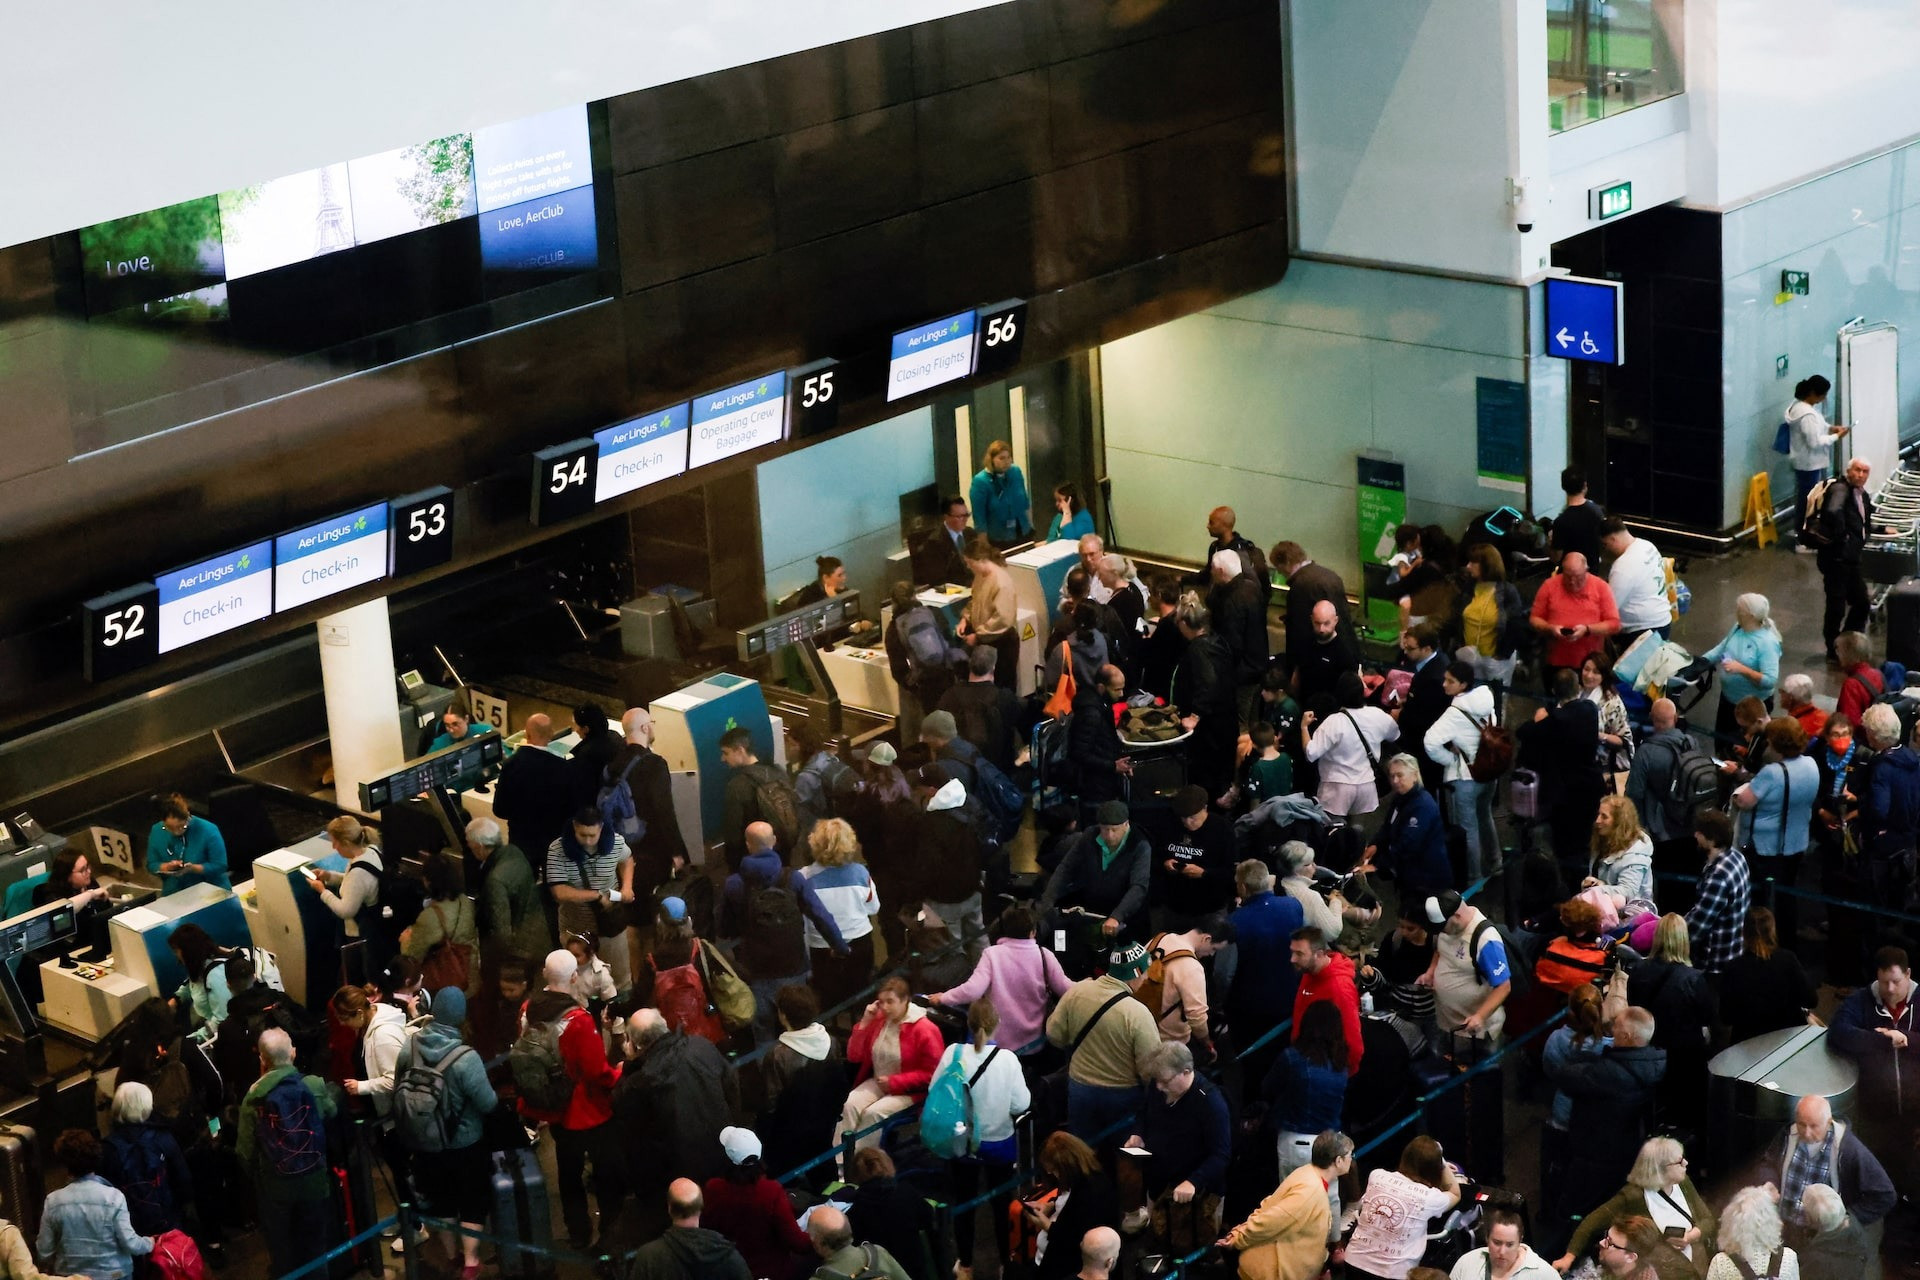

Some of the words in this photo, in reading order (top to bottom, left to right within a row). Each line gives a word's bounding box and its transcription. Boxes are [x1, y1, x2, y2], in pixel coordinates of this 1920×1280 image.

[546, 150, 566, 161] every
[518, 171, 534, 182] take
[535, 166, 552, 177] with
[486, 192, 512, 204] money
[523, 182, 546, 194] future
[498, 217, 524, 232] Love,
[526, 204, 564, 224] AerClub
[907, 335, 922, 348] Aer
[922, 327, 948, 345] Lingus
[985, 314, 1017, 348] 56
[896, 362, 931, 384] Closing
[932, 350, 965, 371] Flights
[710, 397, 726, 411] Aer
[726, 389, 754, 409] Lingus
[802, 371, 834, 408] 55
[612, 431, 631, 445] Aer
[631, 420, 658, 440] Lingus
[700, 416, 749, 441] Operating
[751, 406, 775, 425] Crew
[716, 428, 758, 451] Baggage
[549, 456, 588, 494] 54
[613, 451, 663, 479] Check-in
[298, 533, 317, 550] Aer
[317, 523, 351, 545] Lingus
[407, 503, 446, 543] 53
[178, 575, 198, 591] Aer
[199, 563, 234, 585] Lingus
[302, 555, 359, 585] Check-in
[183, 595, 243, 626] Check-in
[102, 605, 145, 648] 52
[476, 699, 502, 728] 55
[100, 835, 128, 863] 53
[1167, 843, 1204, 857] GUINNESS
[1174, 852, 1193, 860] DUBLIN
